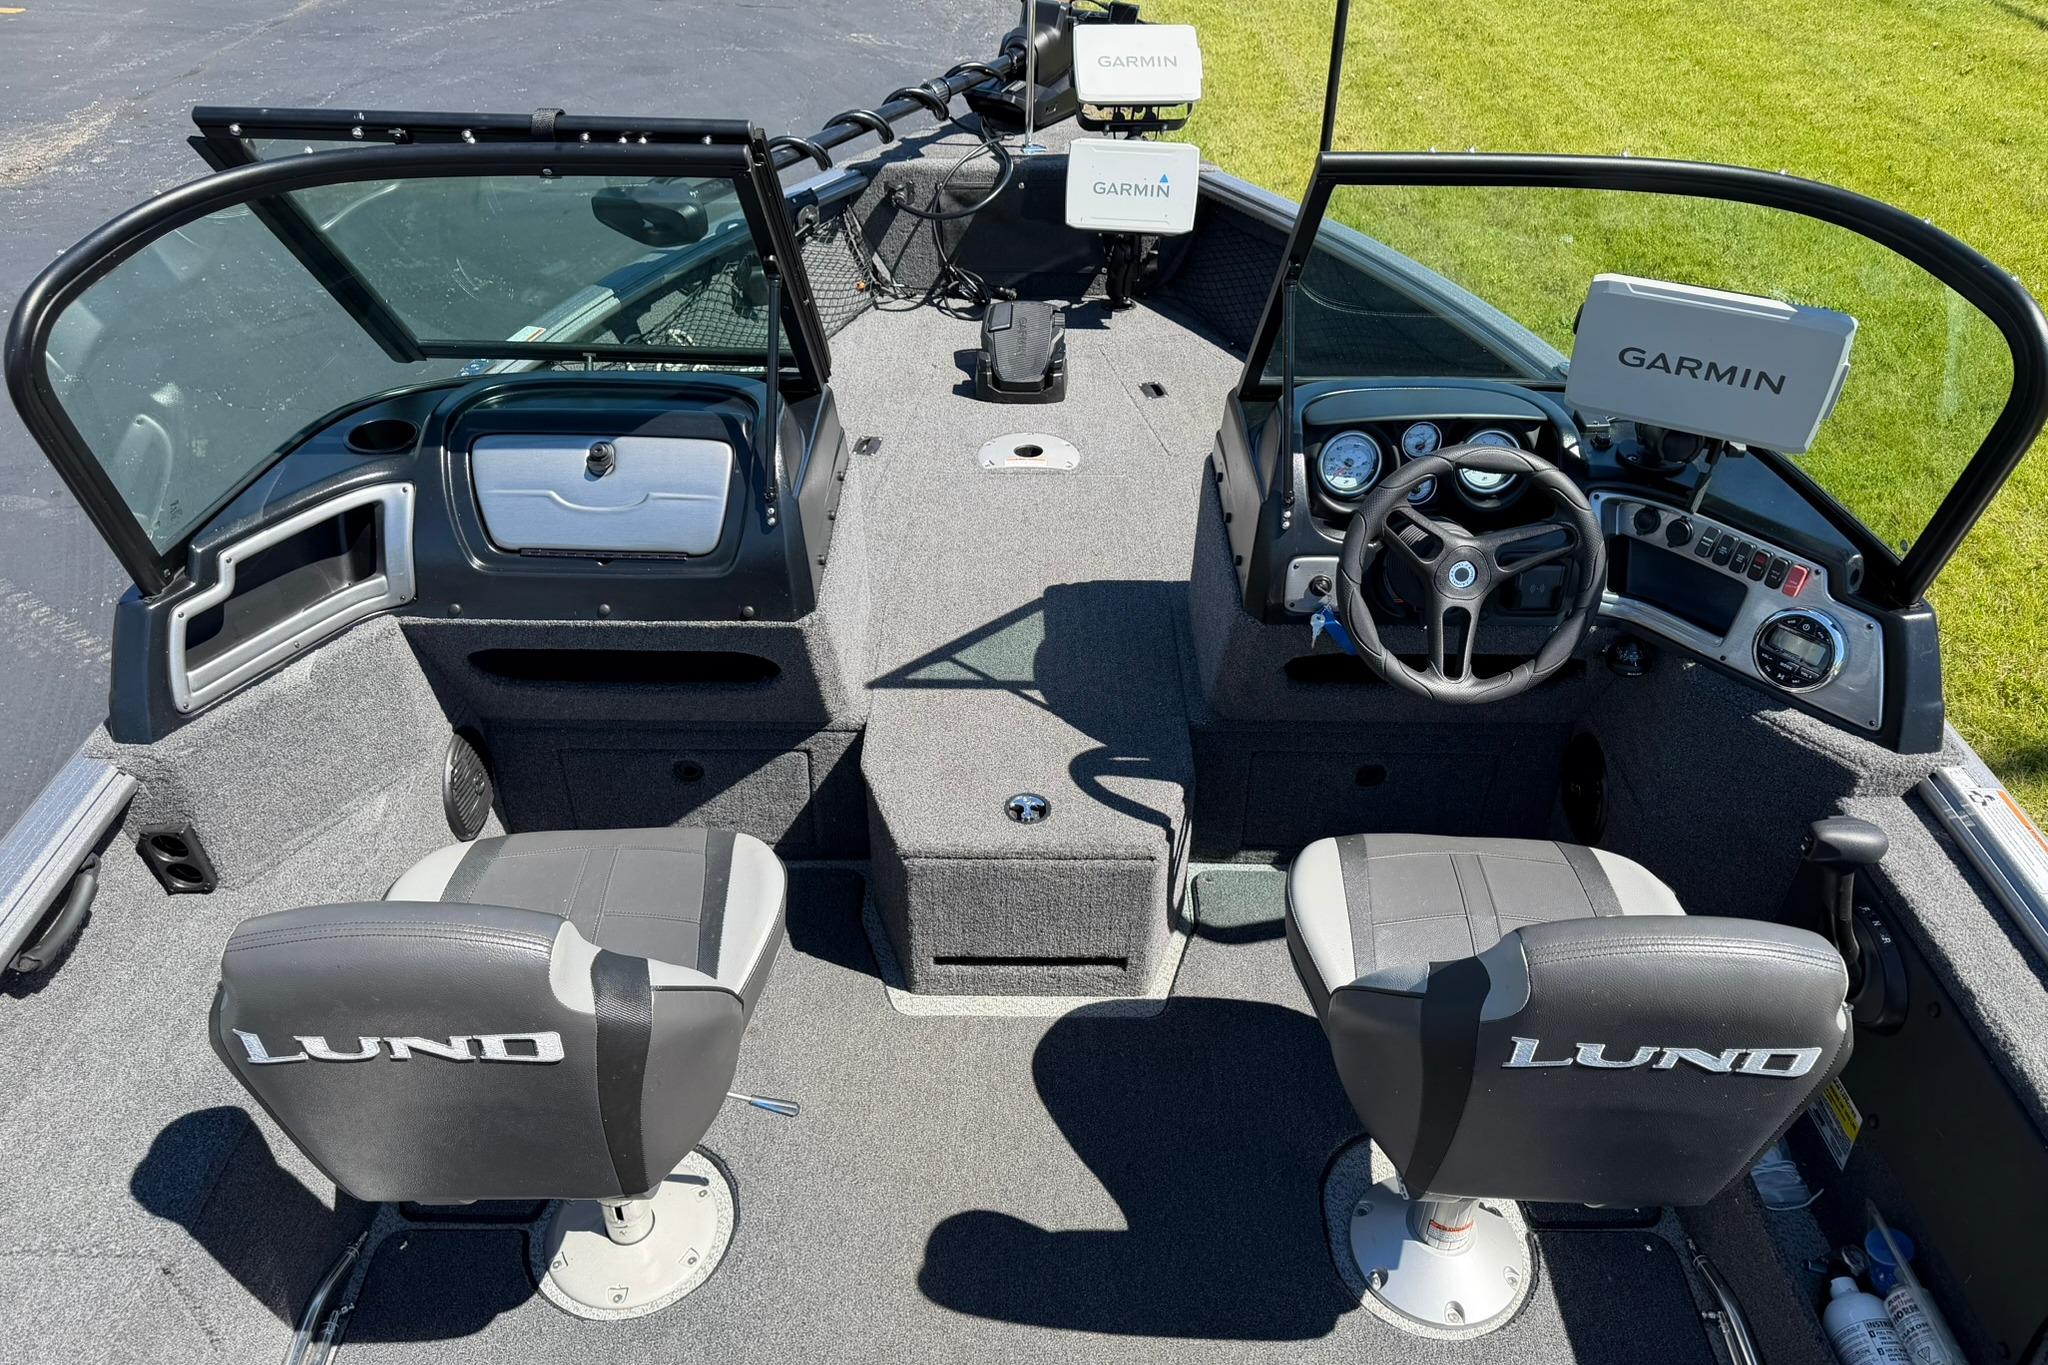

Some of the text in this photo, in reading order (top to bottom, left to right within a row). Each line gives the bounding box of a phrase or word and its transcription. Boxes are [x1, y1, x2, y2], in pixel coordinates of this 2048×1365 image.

[1097, 56, 1177, 68] GARMIN
[1093, 181, 1170, 198] GARMIN
[1618, 347, 1786, 395] GARMIN
[233, 1029, 564, 1064] LUND
[1502, 1036, 1822, 1077] LUND
